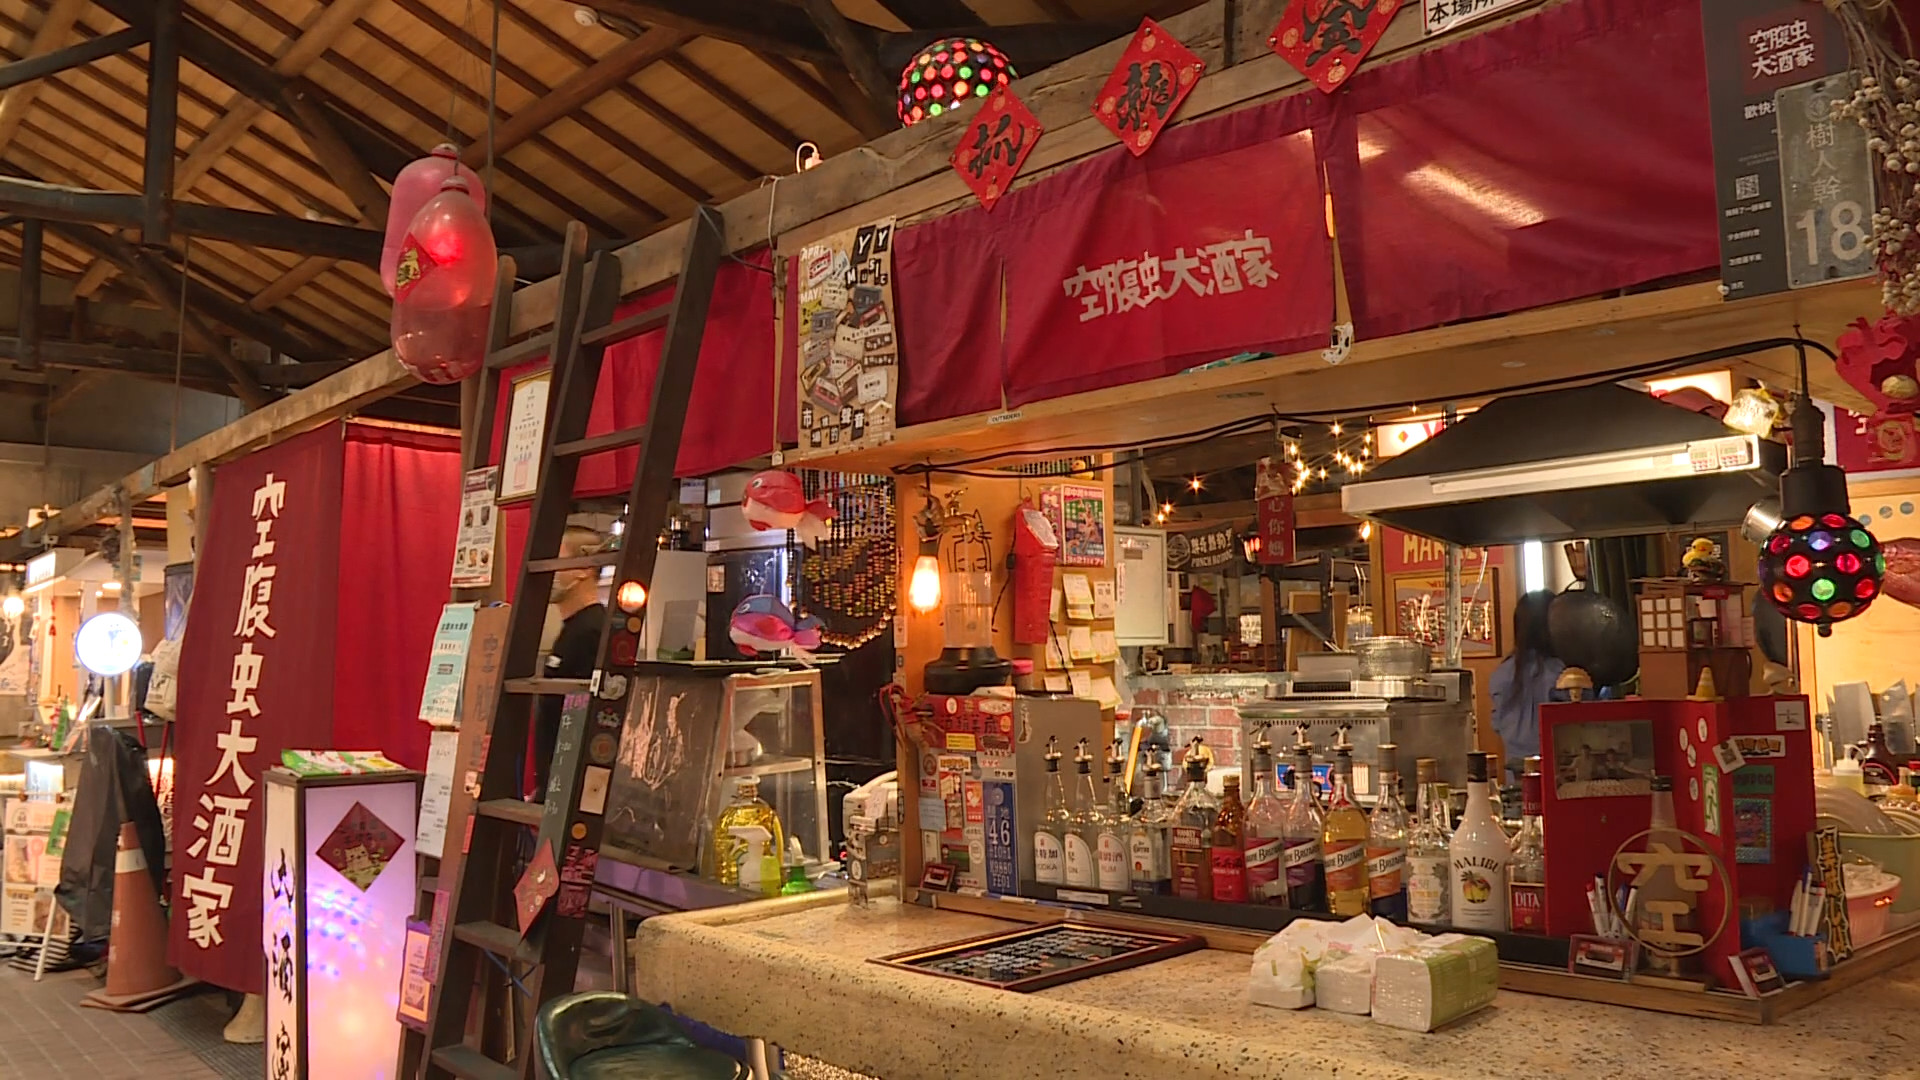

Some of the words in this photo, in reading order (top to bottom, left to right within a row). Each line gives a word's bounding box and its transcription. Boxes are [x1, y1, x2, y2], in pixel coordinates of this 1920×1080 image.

[1749, 19, 1812, 55] 空腹虫
[1751, 43, 1816, 79] 大酒家
[1806, 122, 1841, 205] 樹人幹
[1796, 201, 1867, 266] 18
[1062, 229, 1279, 323] 空腹虫大酒家
[182, 473, 287, 949] 空腹虫大酒家
[989, 818, 1010, 845] 46
[1514, 892, 1541, 908] DITA
